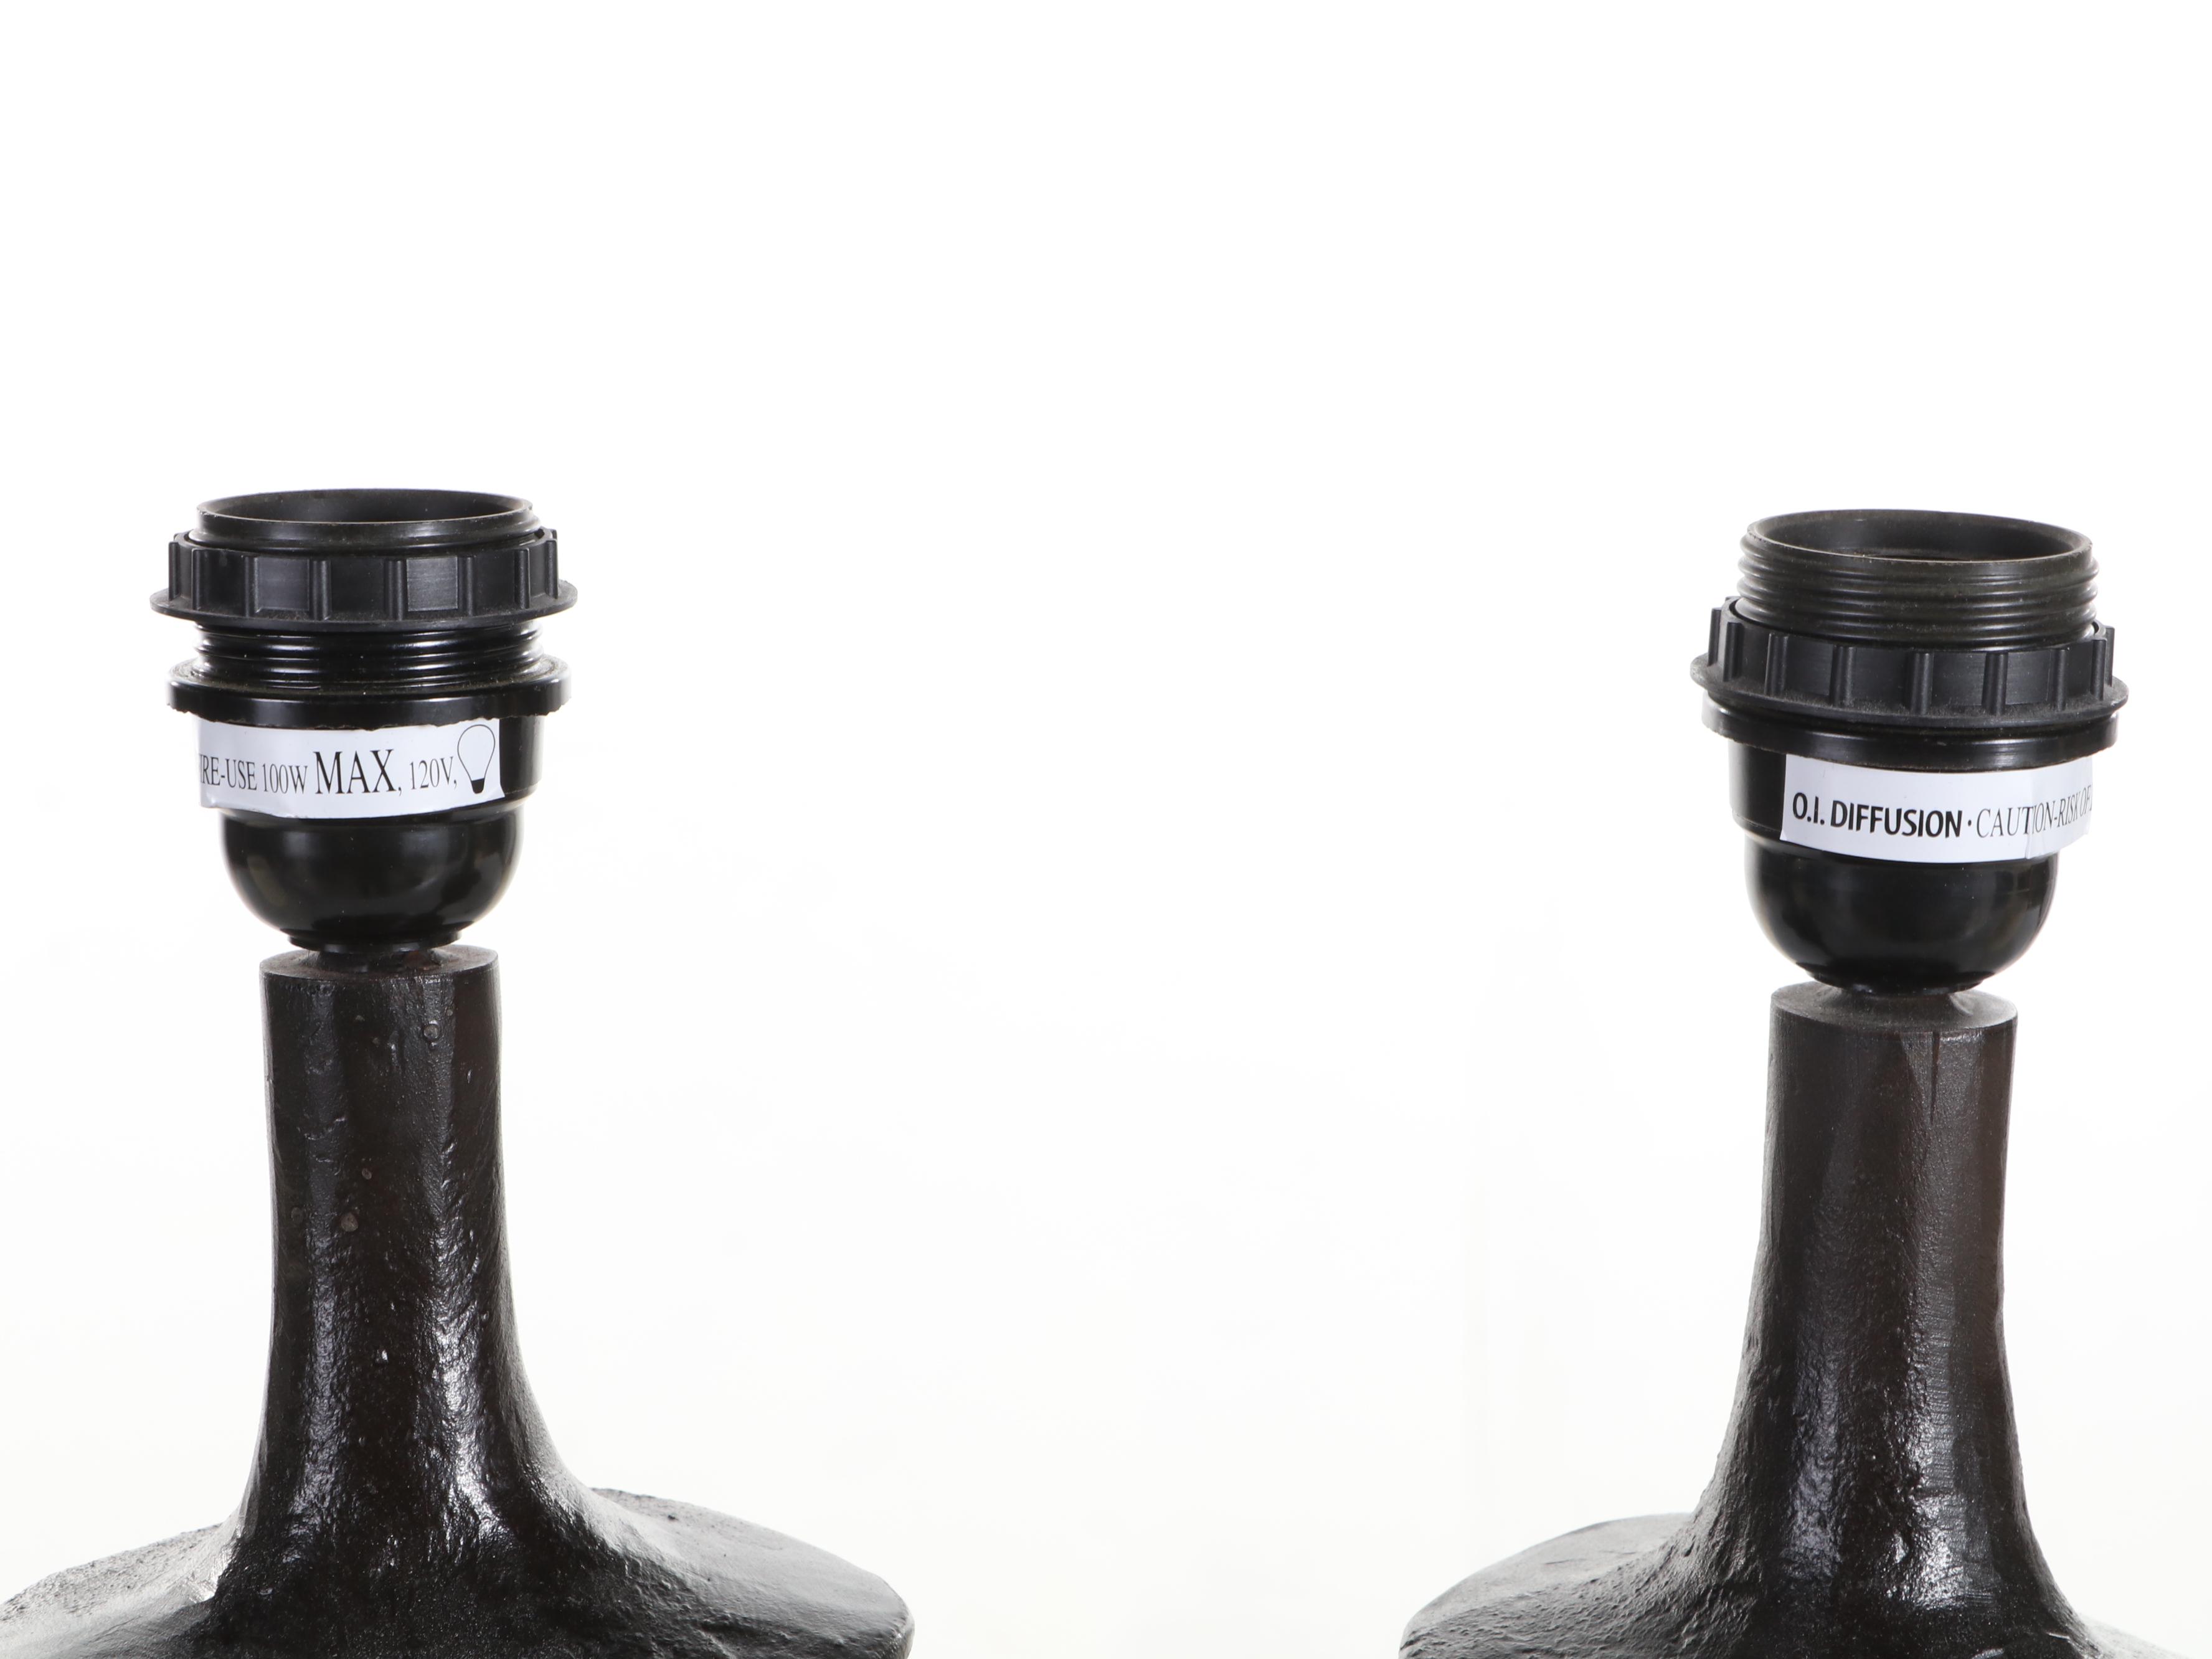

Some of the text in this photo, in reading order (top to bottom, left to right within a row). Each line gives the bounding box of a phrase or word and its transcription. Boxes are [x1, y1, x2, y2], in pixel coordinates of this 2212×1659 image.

[262, 763, 308, 794] 100W
[313, 749, 402, 797] MAX,
[409, 756, 458, 790] 120V,
[1792, 792, 1825, 826] O.I.
[1830, 800, 1963, 838] DIFFUSION
[1976, 791, 2080, 838] CAUTION-RISK
